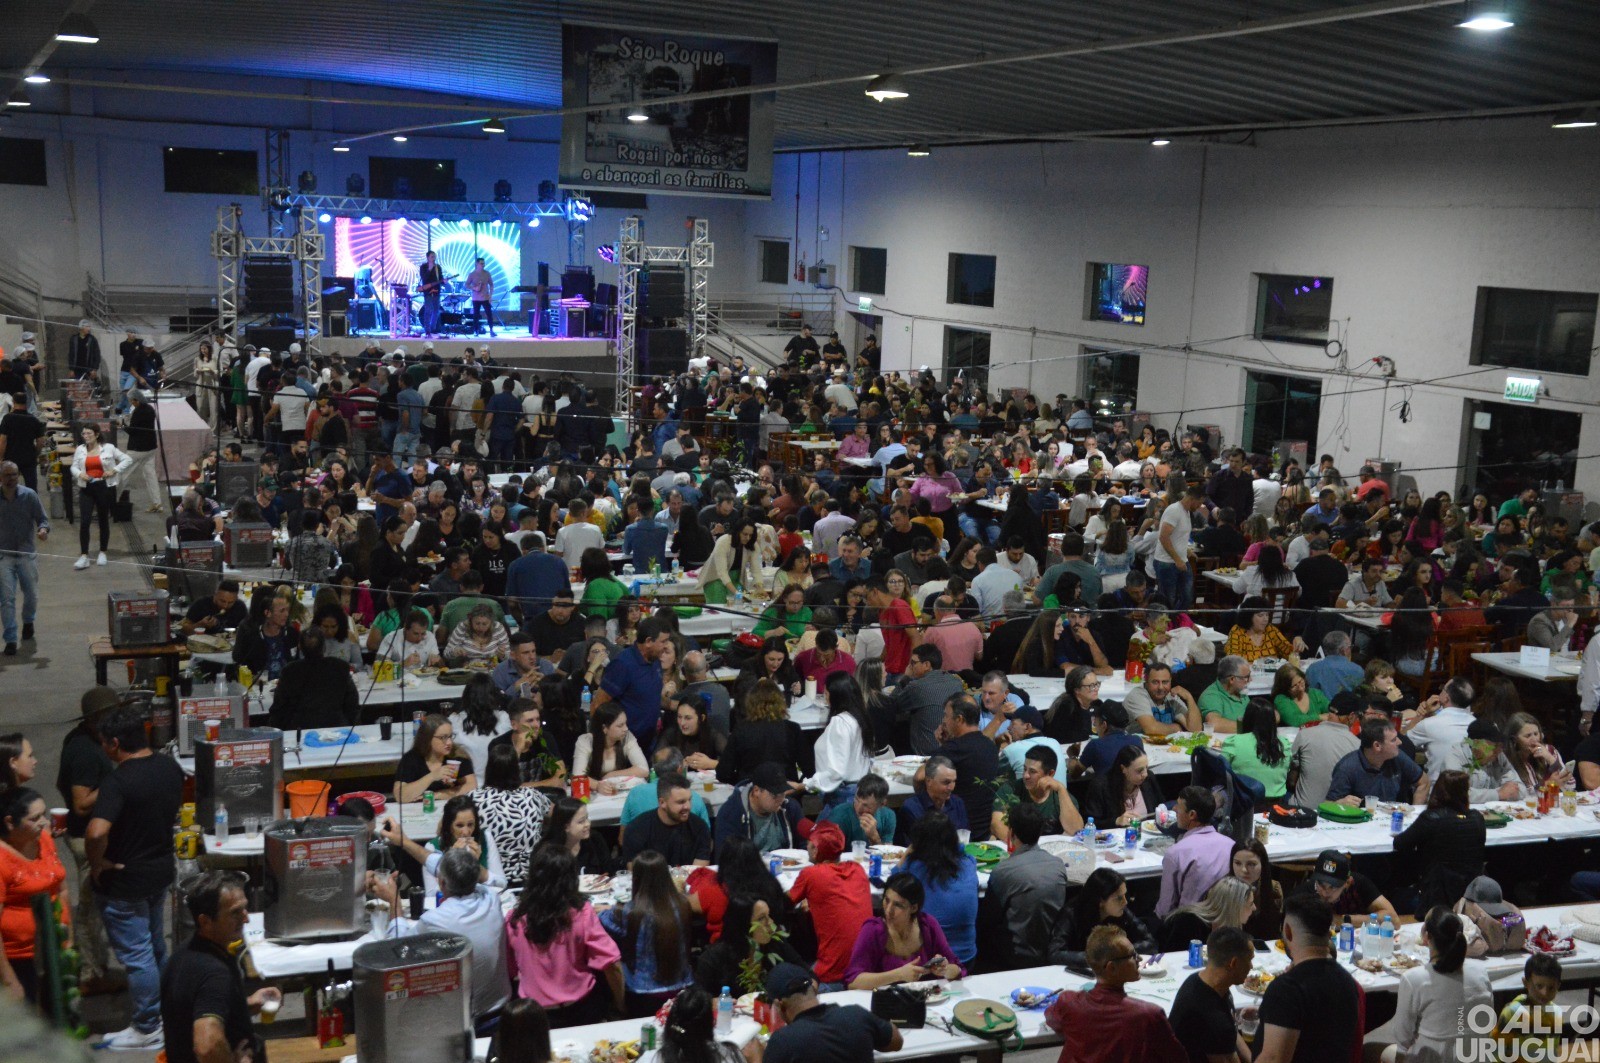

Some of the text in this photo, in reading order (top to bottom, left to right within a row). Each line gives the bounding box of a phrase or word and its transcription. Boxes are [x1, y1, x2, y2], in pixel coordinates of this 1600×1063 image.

[618, 36, 725, 71] São Roque
[617, 143, 659, 165] Rogai
[665, 150, 689, 167] por
[582, 168, 591, 180] e
[596, 165, 660, 186] abençoai
[664, 173, 681, 186] as
